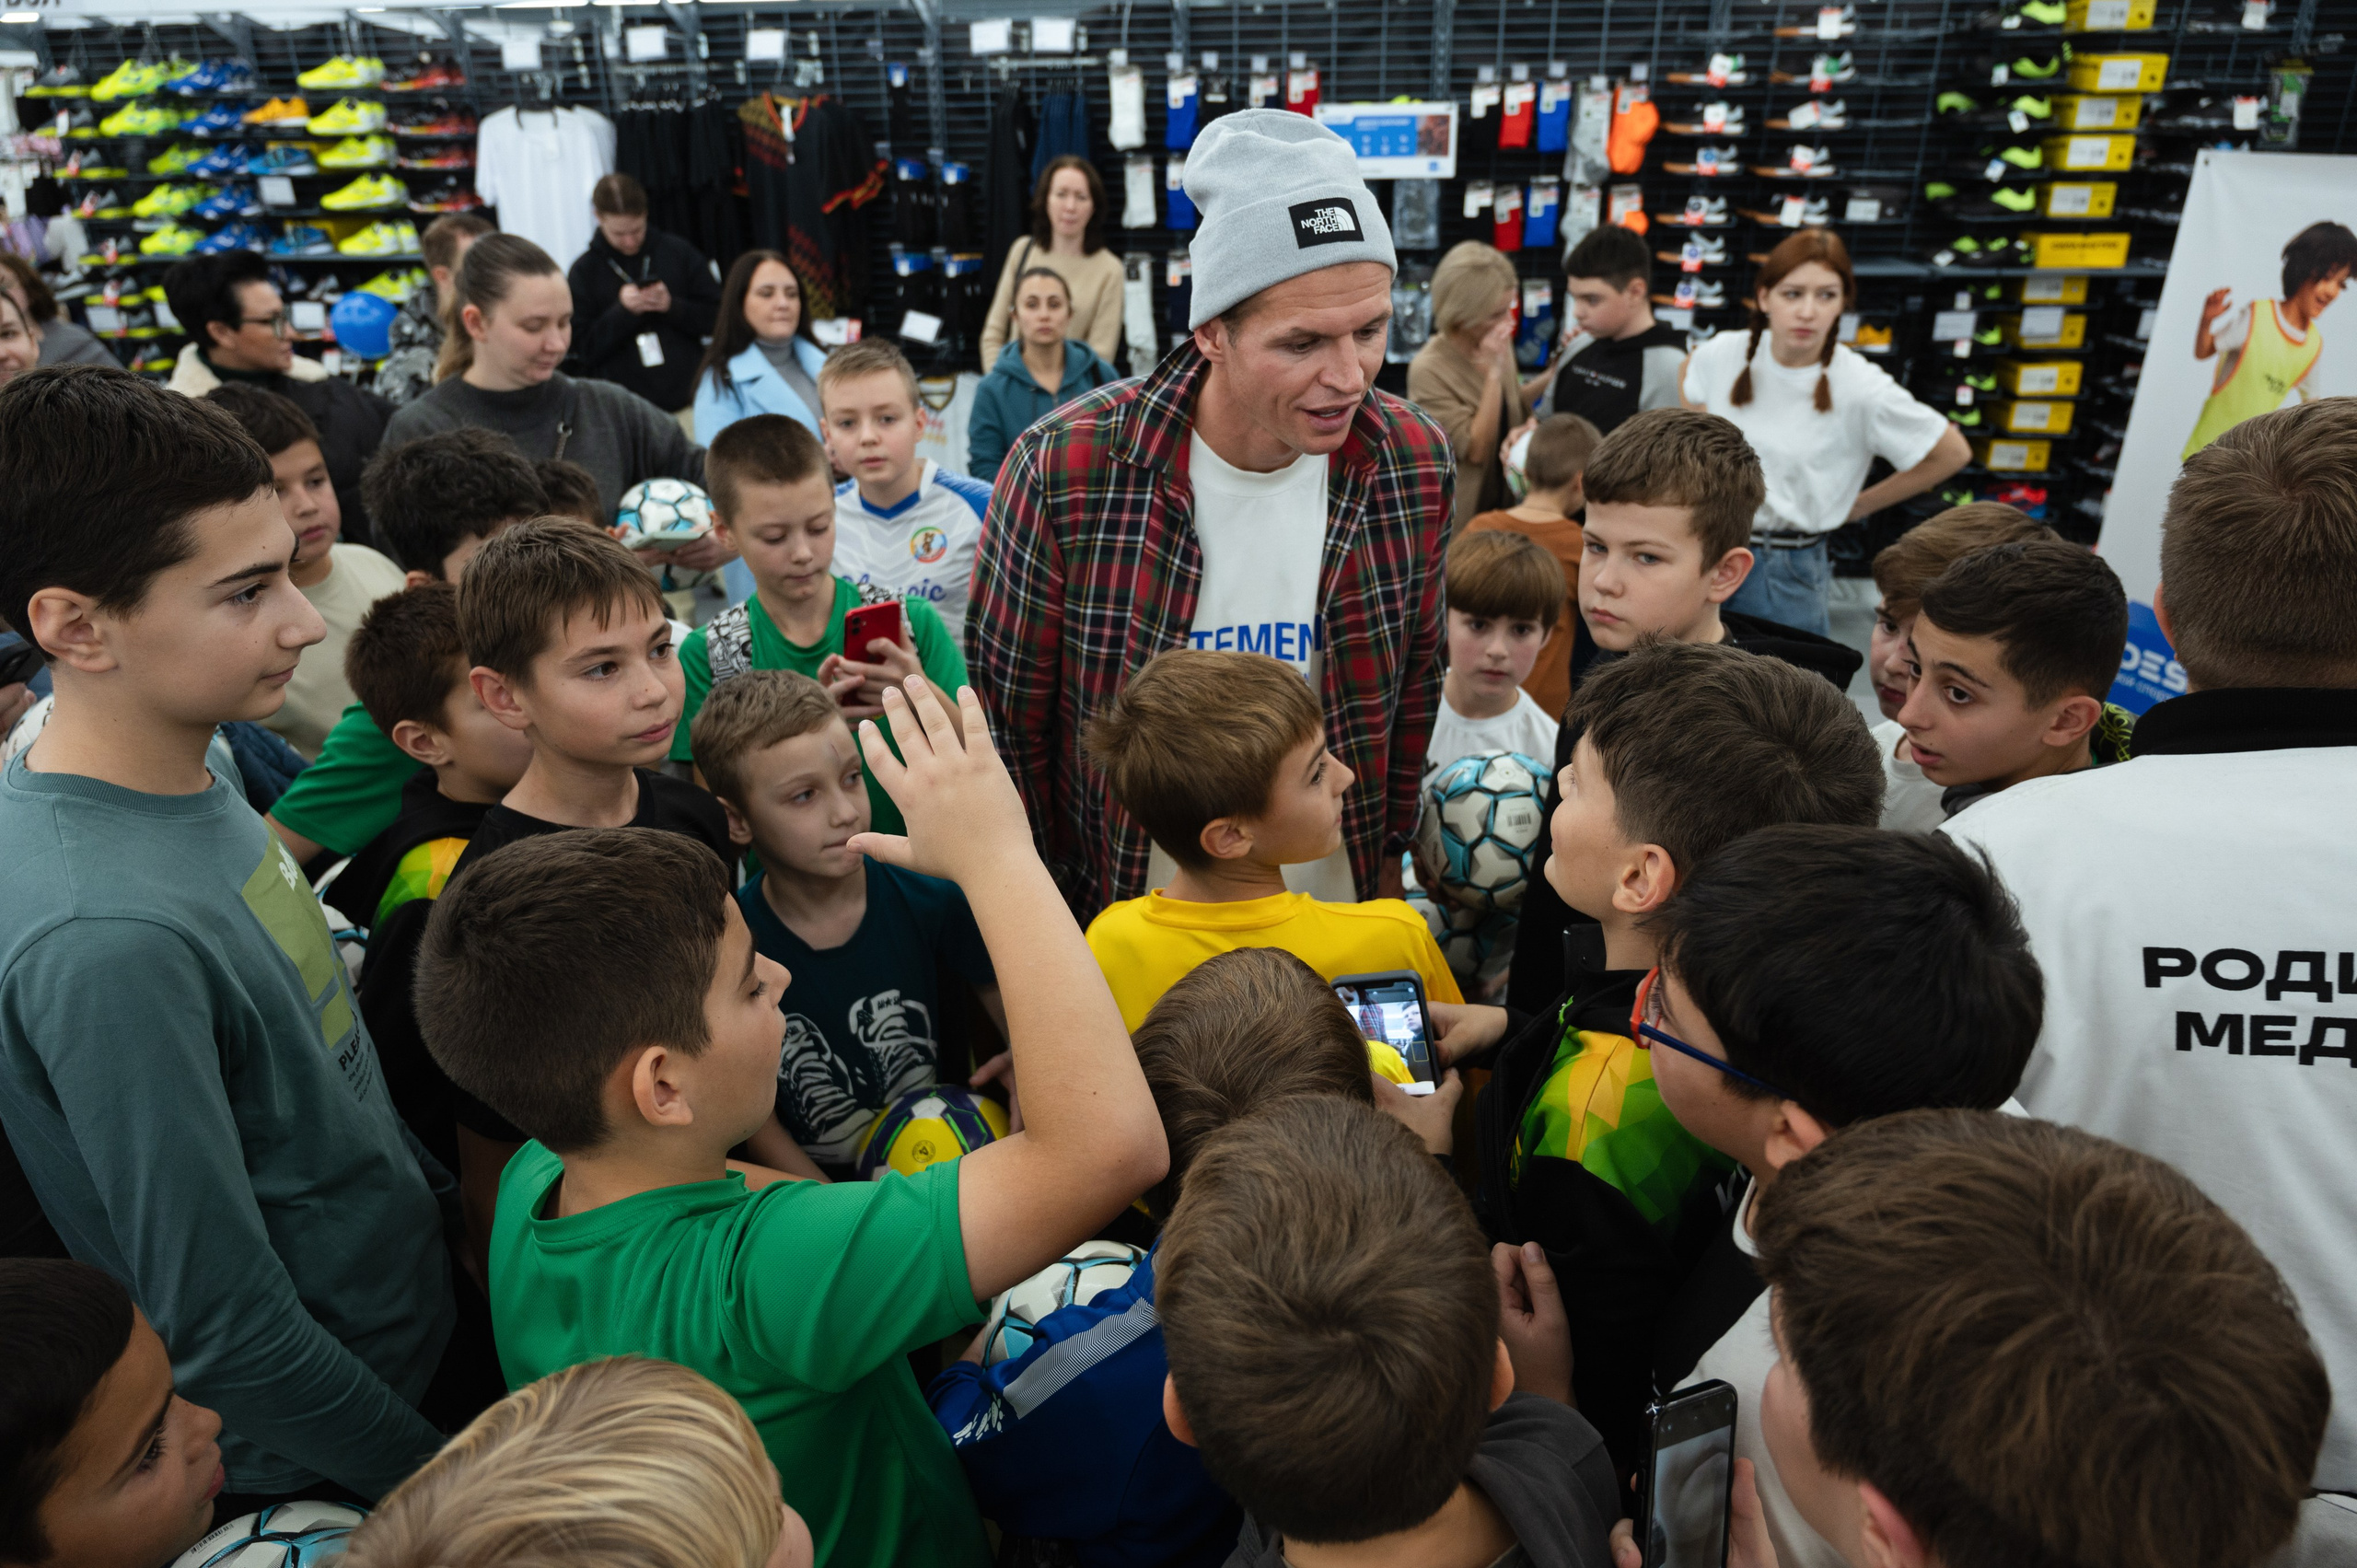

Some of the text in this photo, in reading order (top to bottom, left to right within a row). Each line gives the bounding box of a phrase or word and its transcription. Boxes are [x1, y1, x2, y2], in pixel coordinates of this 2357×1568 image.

[1314, 207, 1335, 218] THE
[1300, 214, 1337, 229] NORTH
[1313, 223, 1340, 235] FACE
[2175, 1011, 2357, 1069] МЕД
